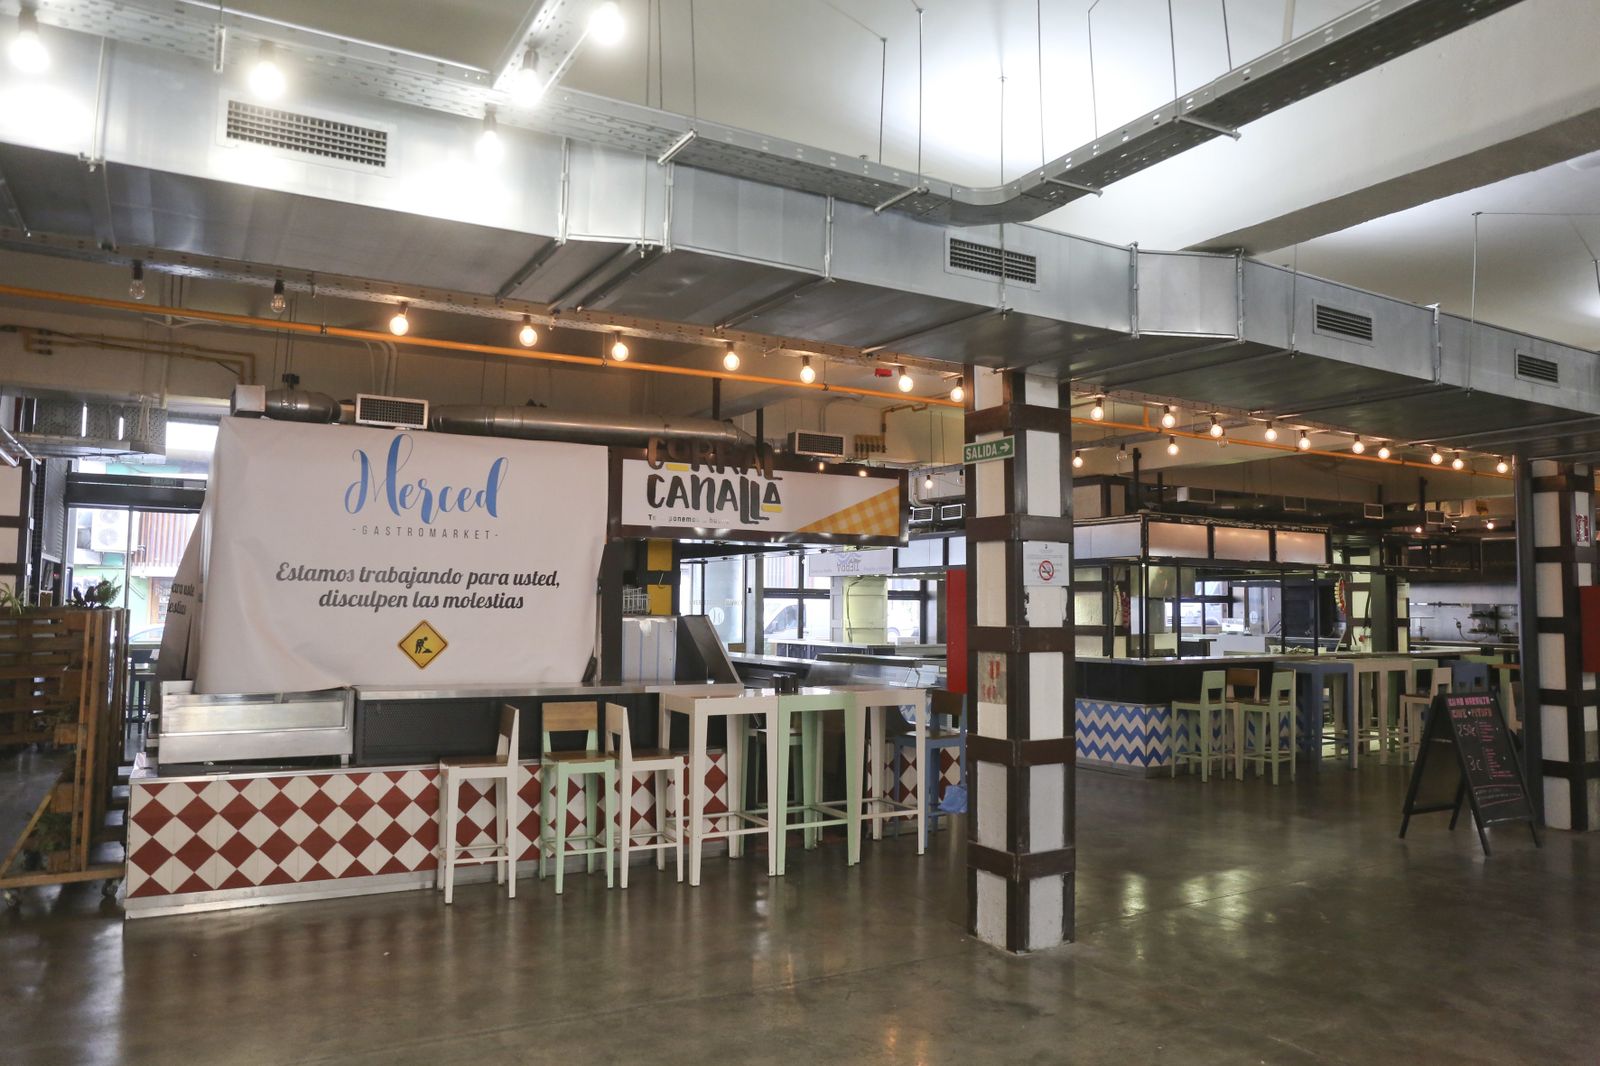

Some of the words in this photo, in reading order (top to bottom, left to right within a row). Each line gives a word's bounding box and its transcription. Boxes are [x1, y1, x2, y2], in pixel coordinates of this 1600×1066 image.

[965, 443, 998, 460] SALIDA
[344, 433, 509, 524] Merced
[646, 473, 783, 525] CANALLA
[275, 561, 355, 583] Estamos
[359, 566, 463, 589] trabajando
[466, 570, 510, 590] para
[513, 570, 560, 588] usted,
[318, 589, 408, 613] disculpen
[412, 591, 439, 609] las
[443, 592, 524, 610] molestias
